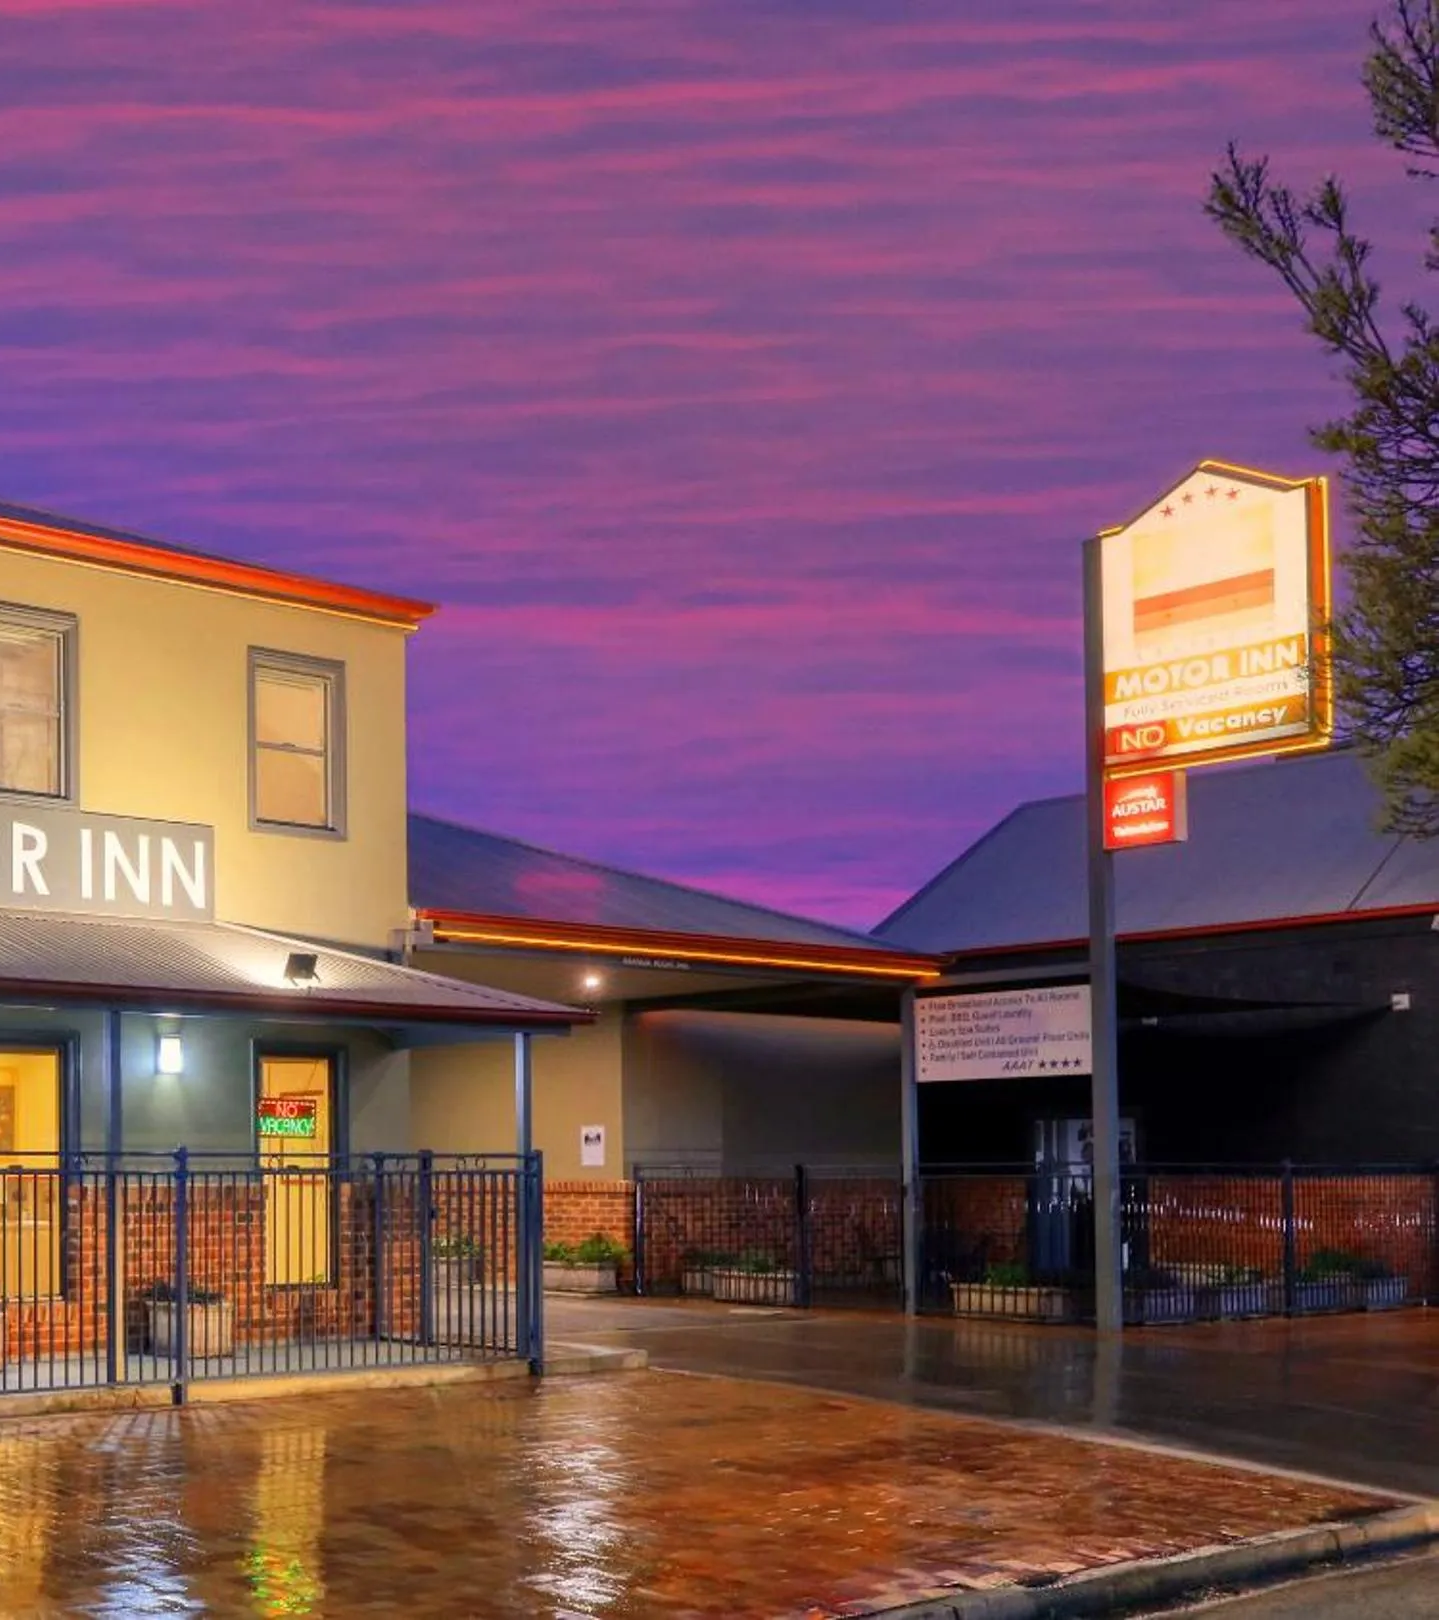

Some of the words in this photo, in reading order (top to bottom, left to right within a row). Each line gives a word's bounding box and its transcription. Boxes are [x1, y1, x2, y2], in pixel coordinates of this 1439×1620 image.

[1115, 655, 1230, 699] MOTOR
[1240, 641, 1297, 676] INN
[1117, 725, 1165, 752] NO
[1176, 705, 1288, 737] Vacancy
[1111, 798, 1168, 818] AUSTAR
[78, 829, 208, 910] INN
[260, 1117, 311, 1133] VACANCY
[275, 1104, 298, 1118] NO
